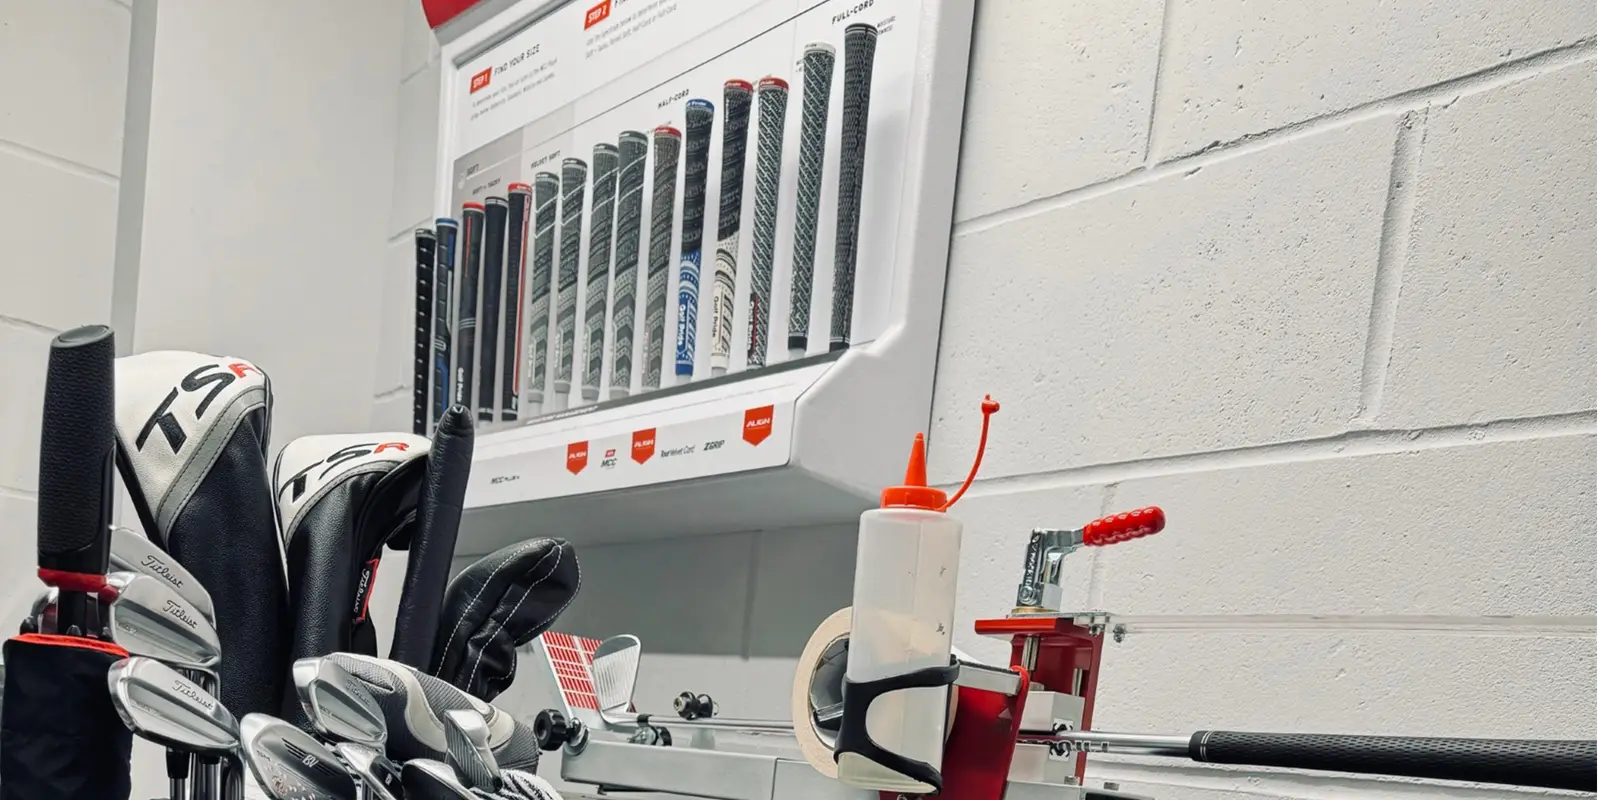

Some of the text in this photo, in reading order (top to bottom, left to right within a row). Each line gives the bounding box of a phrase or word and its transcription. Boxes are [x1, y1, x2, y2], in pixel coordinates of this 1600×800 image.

[588, 10, 602, 24] STEP
[831, 0, 874, 24] FULL-CORD
[494, 44, 540, 76] FIND YOUR SIZE
[657, 88, 690, 110] HALF-CORD
[135, 362, 263, 456] TSR
[746, 418, 770, 428] ALIGN
[568, 451, 586, 459] ALIGN
[634, 440, 654, 448] ALIGN
[278, 442, 410, 503] TSR
[141, 554, 184, 589] Titleist
[162, 600, 198, 630] Titleist
[172, 680, 214, 710] Titleist
